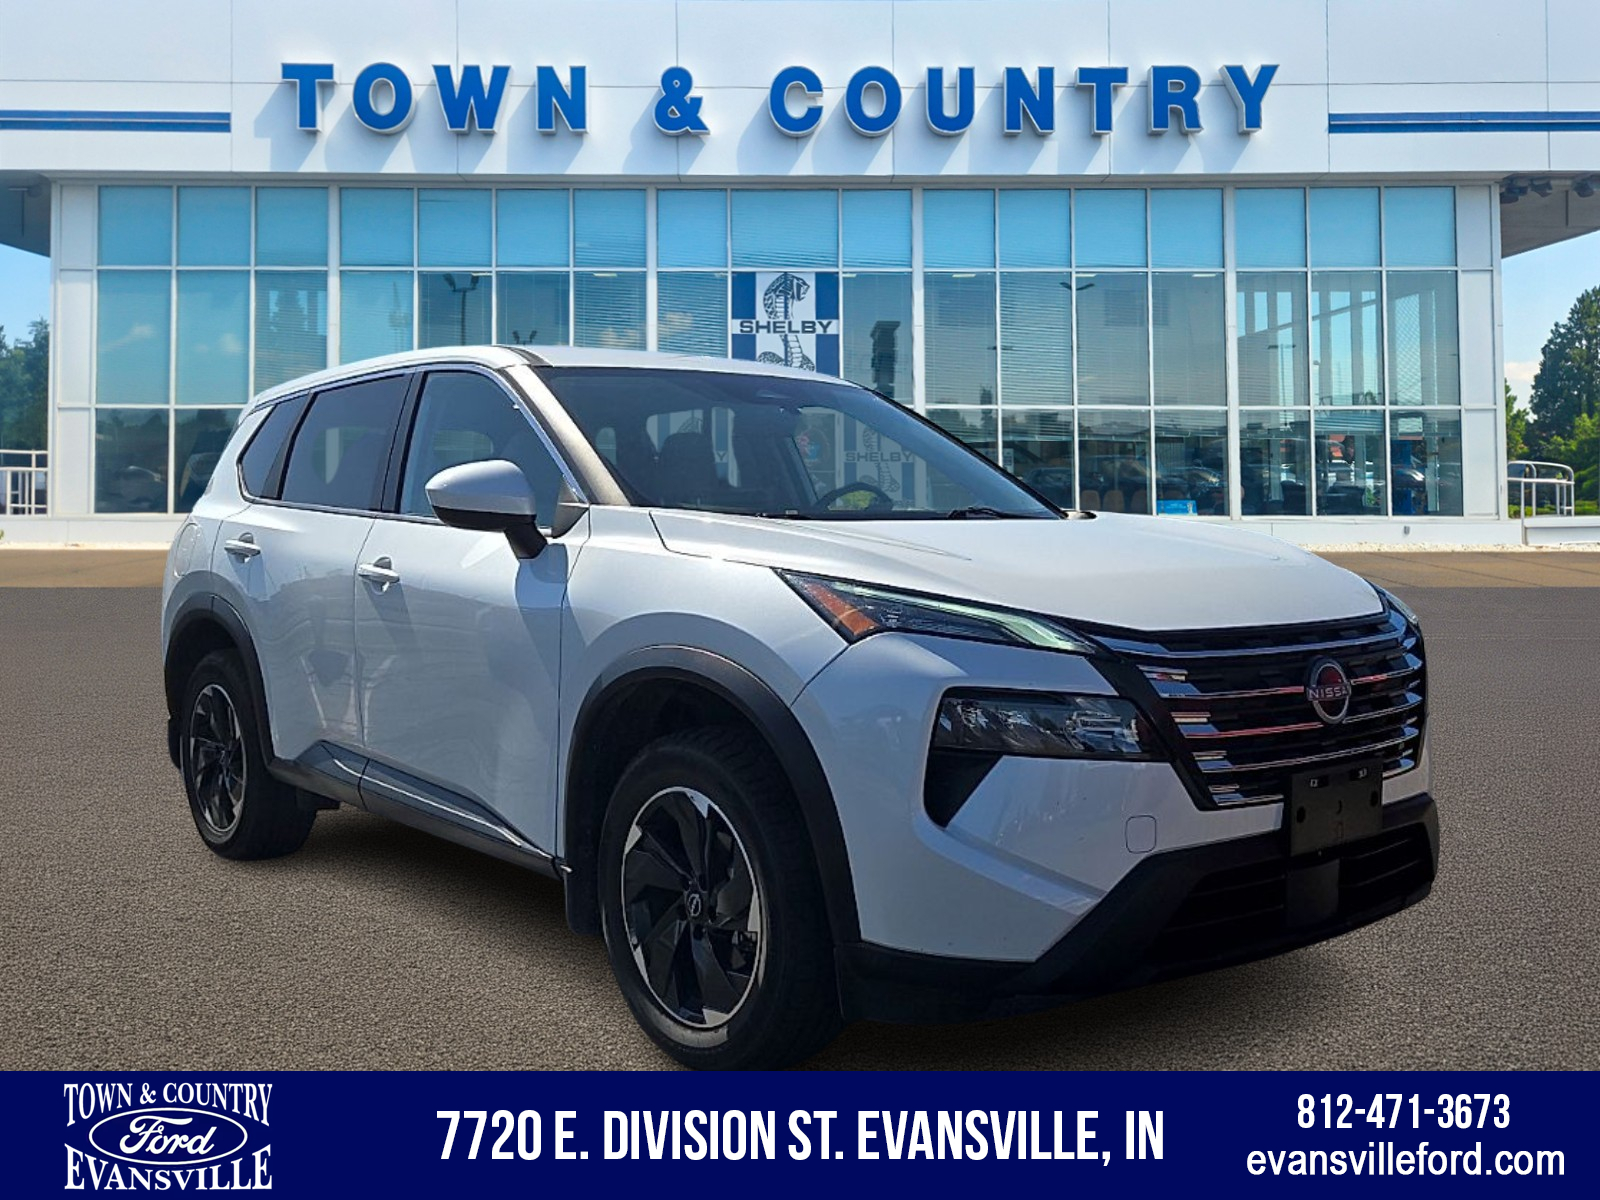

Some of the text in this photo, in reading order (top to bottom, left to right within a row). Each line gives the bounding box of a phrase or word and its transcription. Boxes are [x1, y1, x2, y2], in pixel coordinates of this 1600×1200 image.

[282, 64, 1279, 136] TOWN & COUNTRY
[739, 320, 832, 334] SHELBY
[845, 451, 914, 463] SHELBY
